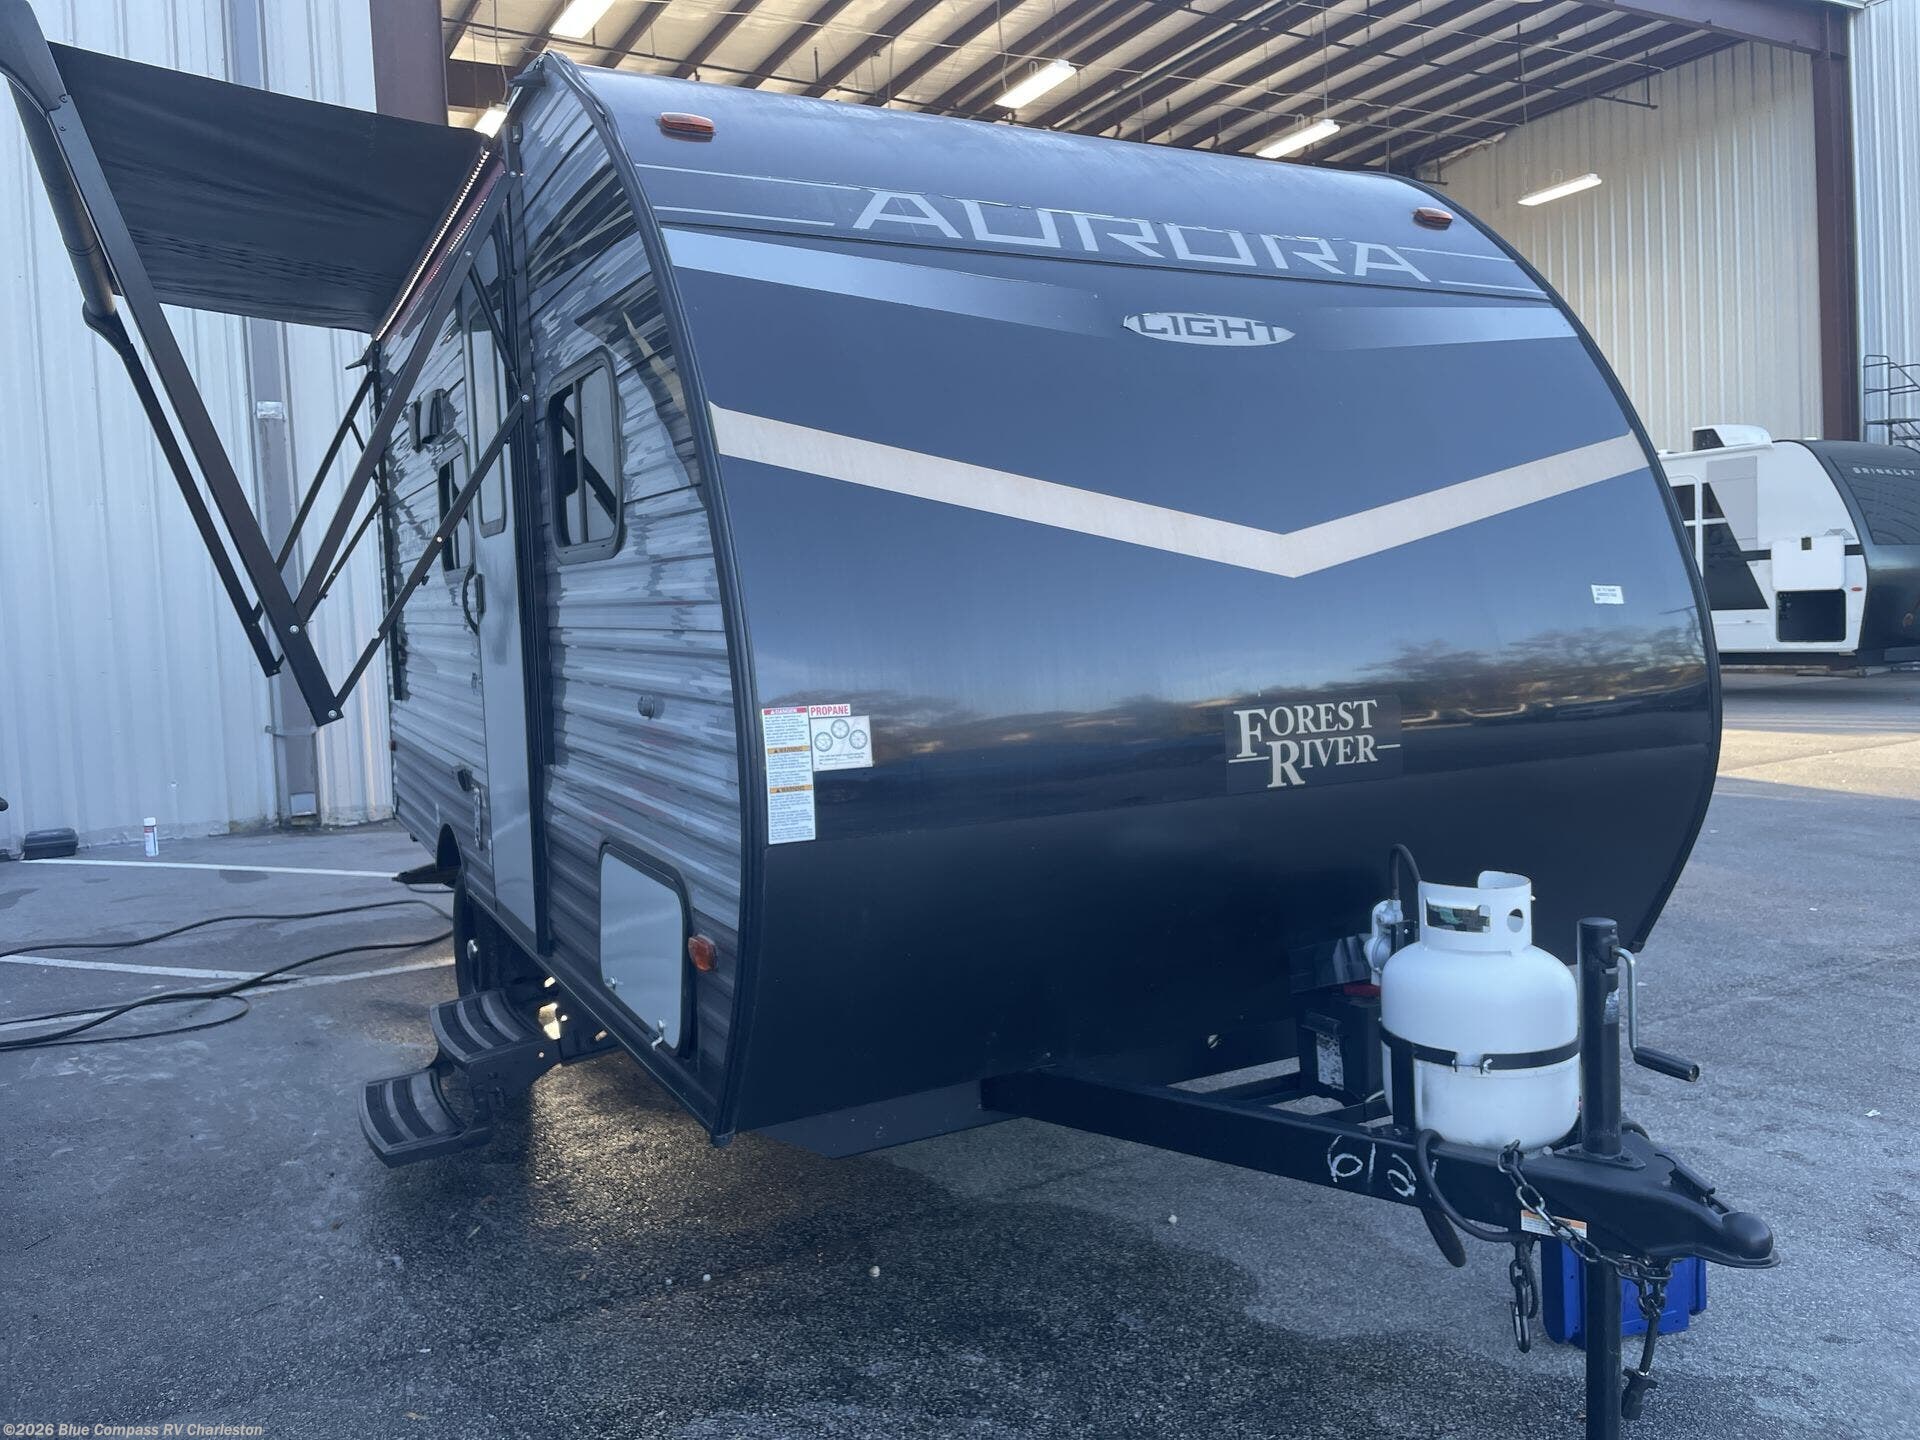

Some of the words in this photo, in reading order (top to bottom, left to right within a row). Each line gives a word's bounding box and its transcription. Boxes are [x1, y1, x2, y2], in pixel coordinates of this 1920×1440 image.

[852, 189, 1429, 282] AURORA
[1137, 313, 1277, 342] LIGHT
[810, 705, 849, 716] PROPANE
[1233, 699, 1378, 758] FOREST
[1266, 734, 1378, 788] RIVER
